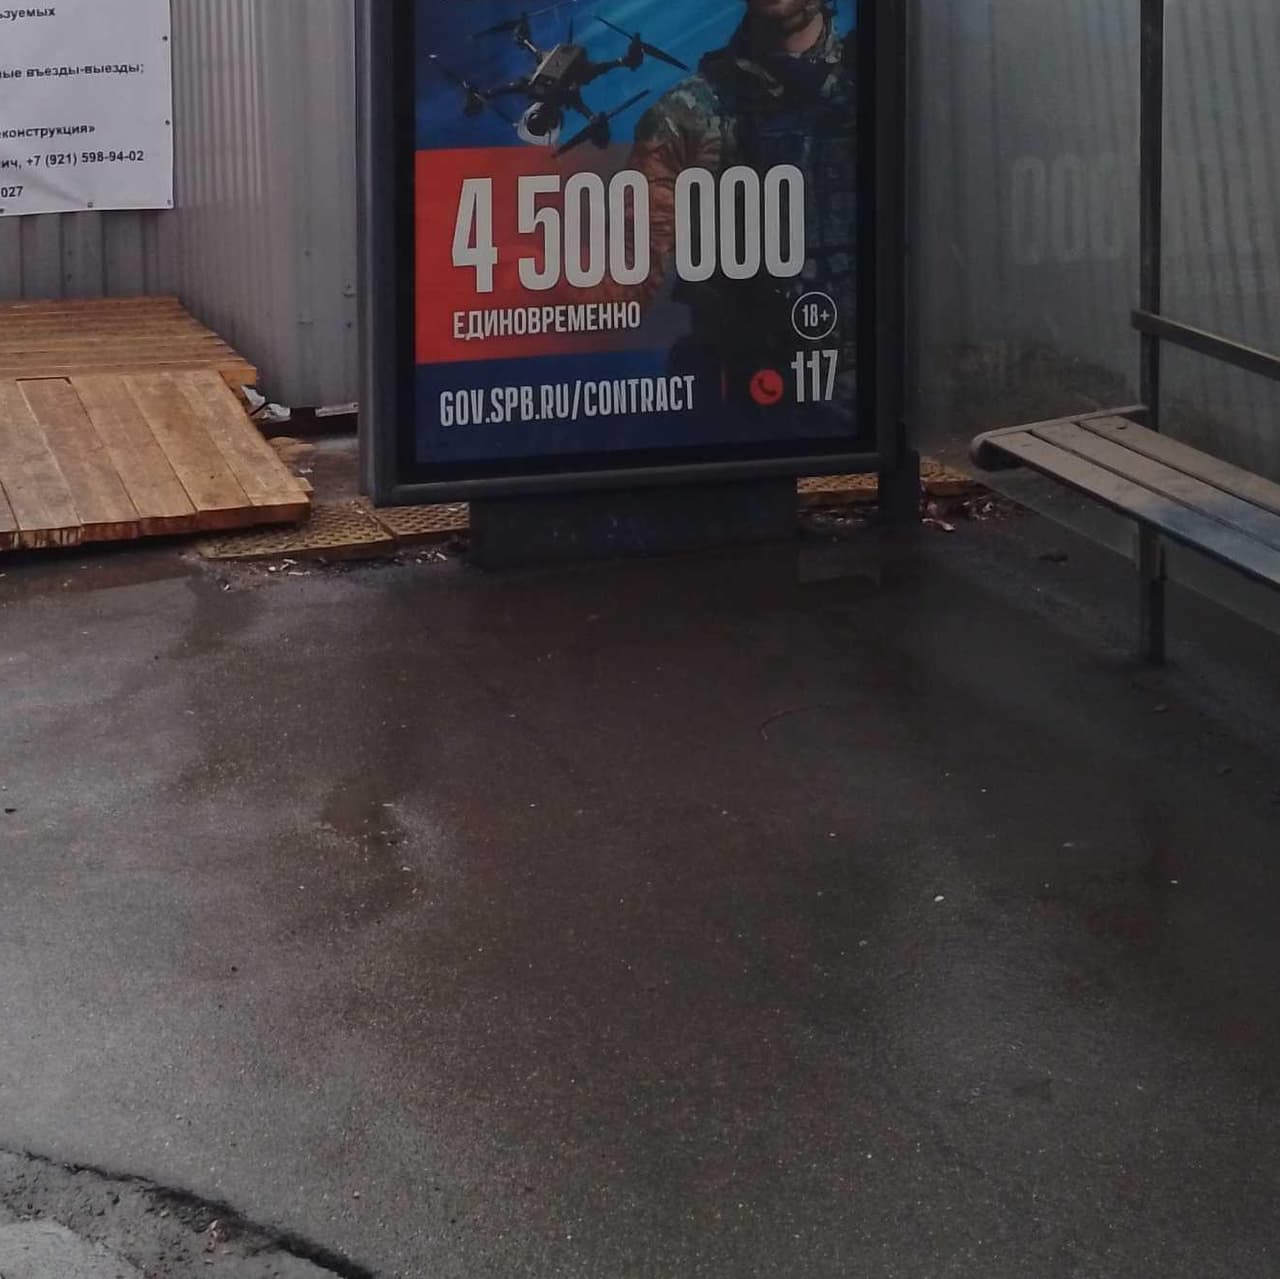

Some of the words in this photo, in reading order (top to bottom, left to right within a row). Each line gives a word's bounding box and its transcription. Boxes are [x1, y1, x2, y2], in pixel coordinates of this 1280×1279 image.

[24, 155, 42, 165] +7
[44, 153, 78, 167] (921)
[80, 150, 145, 163] 598-94-02
[452, 177, 497, 294] 4
[517, 169, 651, 292] 500
[673, 164, 805, 283] 000
[453, 300, 642, 340] ЕДИНОВРЕМЕННО
[801, 303, 830, 327] 18+
[790, 348, 838, 403] 117
[439, 375, 696, 428] GOV.SPB.RU/CONTRACT
